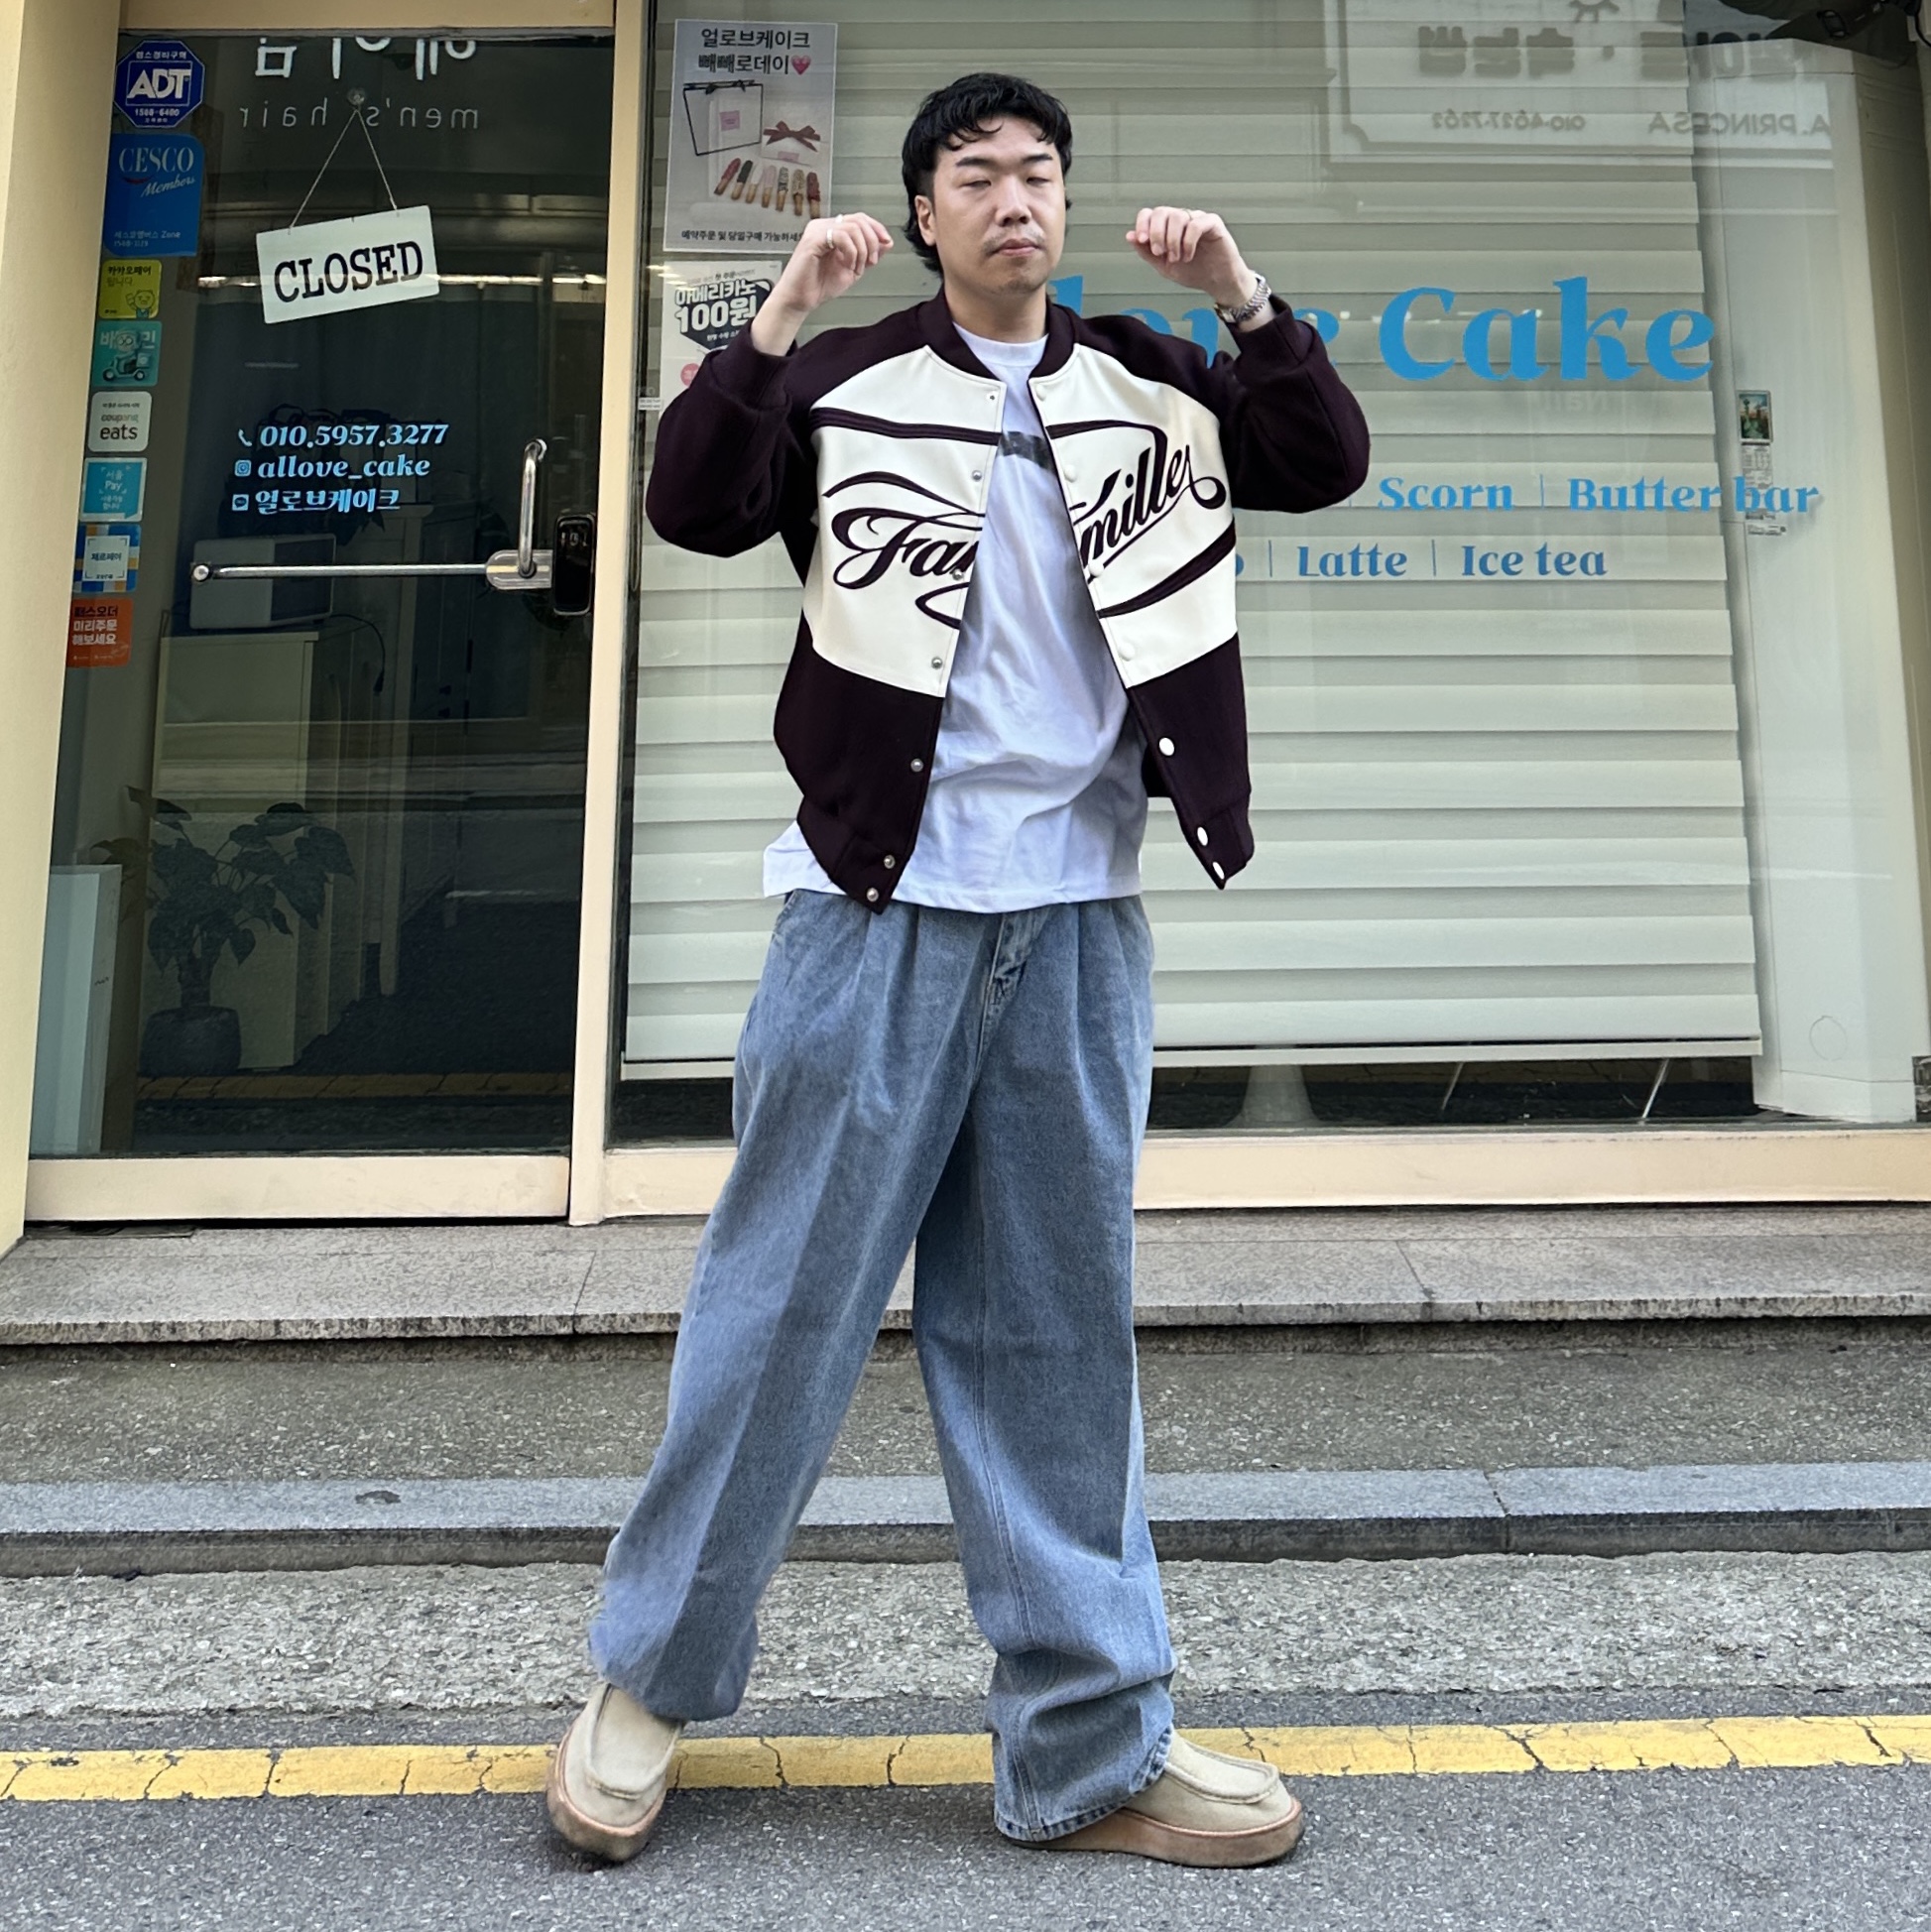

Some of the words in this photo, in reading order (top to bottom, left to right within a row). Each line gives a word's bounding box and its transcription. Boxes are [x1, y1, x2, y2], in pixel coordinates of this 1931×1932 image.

[701, 28, 810, 50] 얼로브케이크
[698, 54, 788, 74] 빼빼로데이
[126, 68, 191, 99] ADT
[119, 147, 194, 173] CESCO
[141, 174, 195, 197] Members
[108, 266, 151, 276] 카카오페이
[274, 241, 423, 302] CLOSED
[676, 280, 757, 305] 아메리카노
[675, 295, 757, 333] 100원
[1380, 277, 1715, 382] Cake
[100, 424, 138, 439] eats
[260, 423, 448, 447] 010.5957.3277
[257, 453, 430, 479] allove_cake
[105, 481, 122, 491] Pay
[1378, 477, 1513, 511] Scorn
[1568, 476, 1722, 512] Butter
[1733, 476, 1819, 513] bar
[255, 488, 401, 515] 얼로브케이크
[91, 552, 122, 561] 제로페이
[1297, 543, 1408, 577] Latte
[1461, 545, 1524, 577] Ice
[1534, 542, 1608, 576] tea
[73, 619, 118, 632] 미리주문
[72, 634, 116, 645] 해보세요
